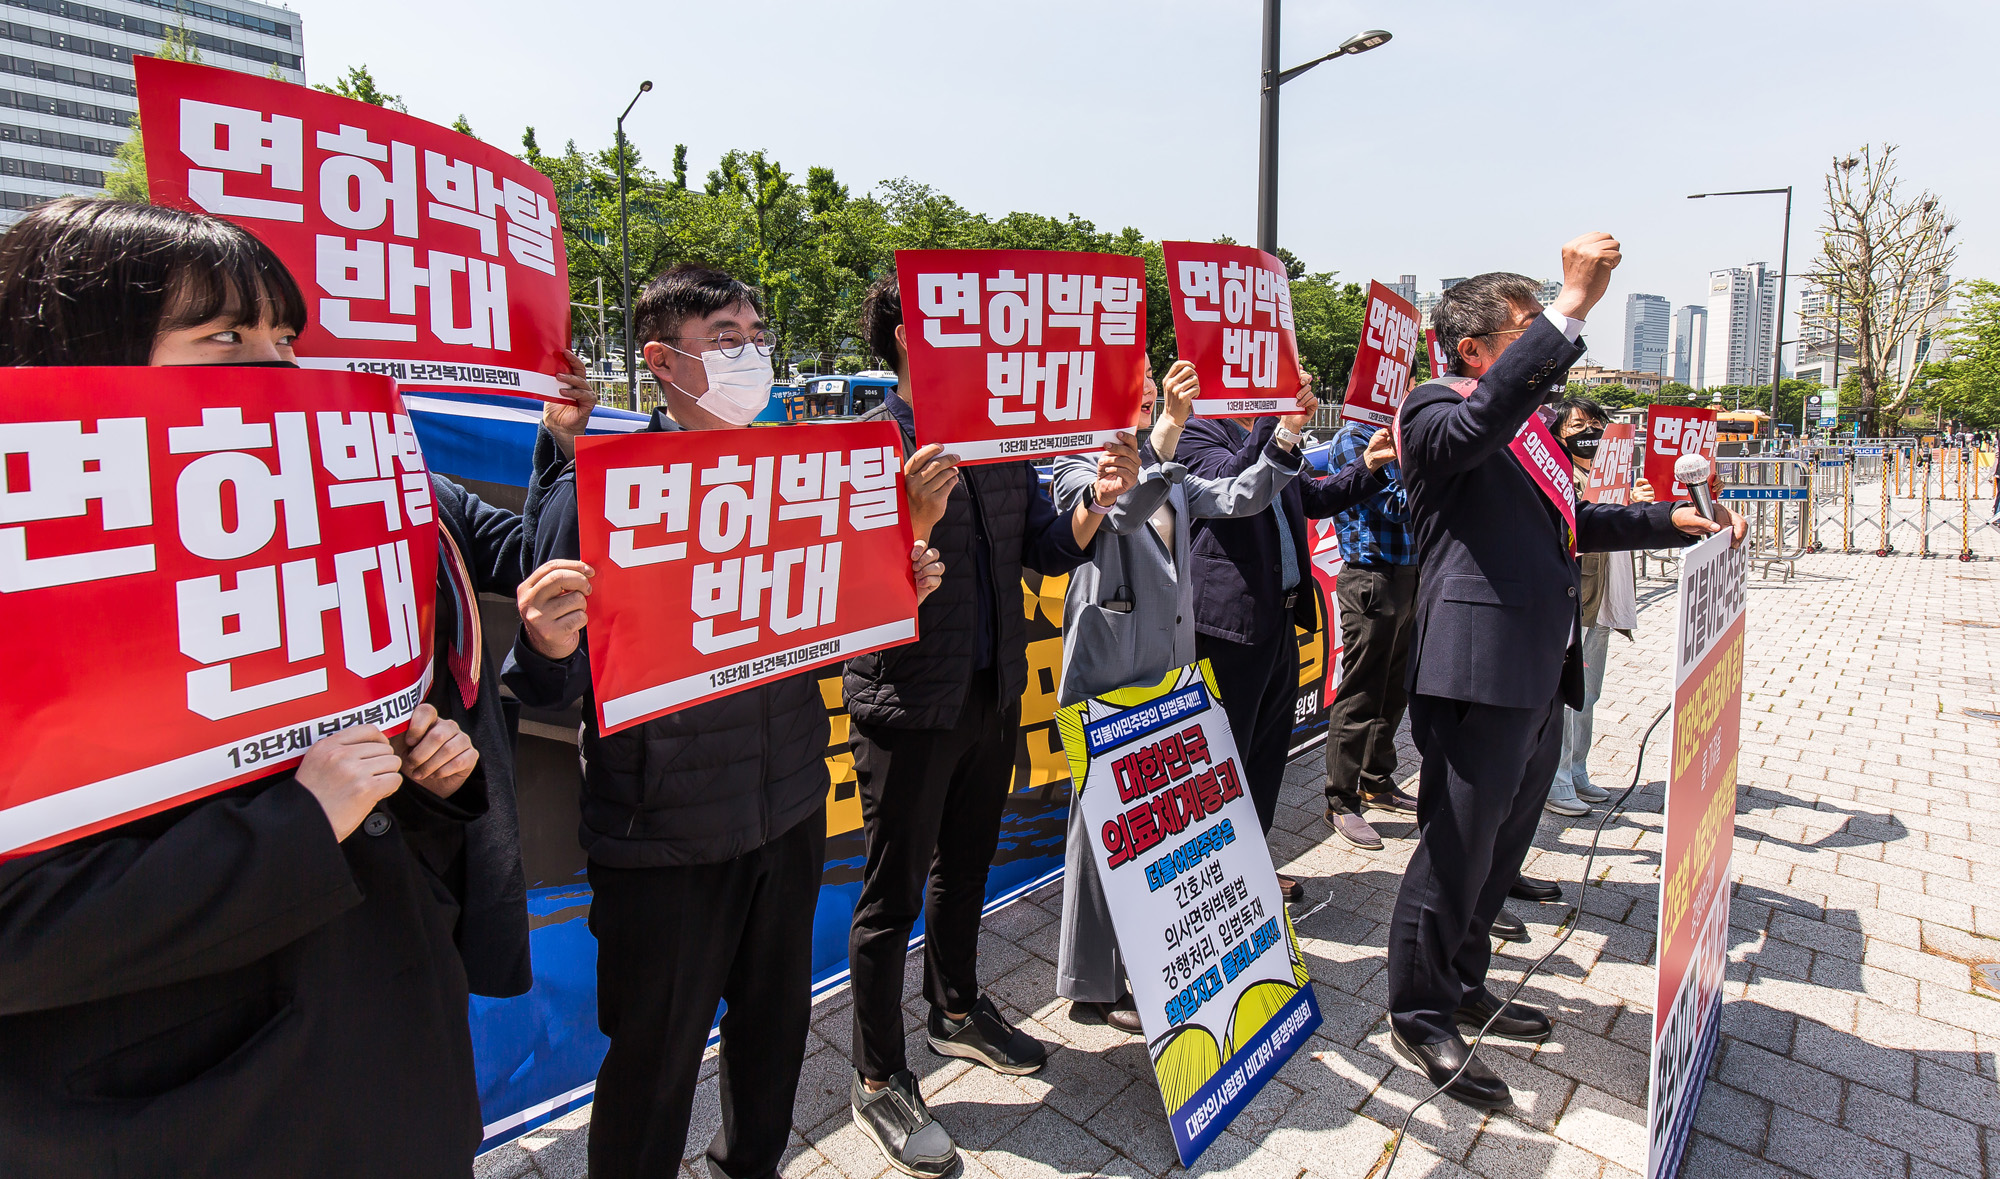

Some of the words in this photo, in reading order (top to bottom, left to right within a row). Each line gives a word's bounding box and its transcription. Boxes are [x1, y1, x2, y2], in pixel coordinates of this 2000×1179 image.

[180, 99, 557, 277] 면허박탈
[316, 234, 511, 352] 반대
[918, 270, 1143, 347] 면허박탈
[1178, 261, 1293, 331] 면허박탈
[410, 363, 521, 387] 보건복지의료연대
[987, 351, 1095, 427] 반대
[1222, 328, 1279, 388] 반대
[1371, 356, 1407, 409] 반대
[999, 440, 1027, 453] 13단체
[1029, 434, 1093, 451] 보건복지의료연대
[1227, 401, 1243, 411] 13단체
[1653, 417, 1719, 463] 면허박
[0, 407, 434, 593] 면허박탈
[605, 446, 901, 568] 면허박탈
[1746, 490, 1784, 498] LINE
[176, 540, 421, 721] 반대
[691, 541, 842, 655] 반대
[1682, 545, 1746, 668] 더불어민주당은
[709, 664, 749, 688] 13단체
[752, 639, 840, 676] 보건복지의료연대
[228, 726, 312, 768] 13단체
[1090, 706, 1160, 747] 더불어민주당의
[1111, 723, 1212, 805] 대한민국
[1101, 757, 1244, 871] 의료체계붕괴
[1144, 818, 1236, 893] 더불어민주당은
[1173, 859, 1225, 909] 간호사법
[1165, 875, 1249, 951] 의사면허박탈법
[1218, 896, 1265, 947] 입법독재
[1165, 964, 1224, 1027] 책임지고
[1185, 1066, 1247, 1141] 대한의사협회
[1244, 1039, 1274, 1080] 비대위
[1270, 1000, 1312, 1051] 투쟁위원회
[1654, 956, 1698, 1150] 책임지고
